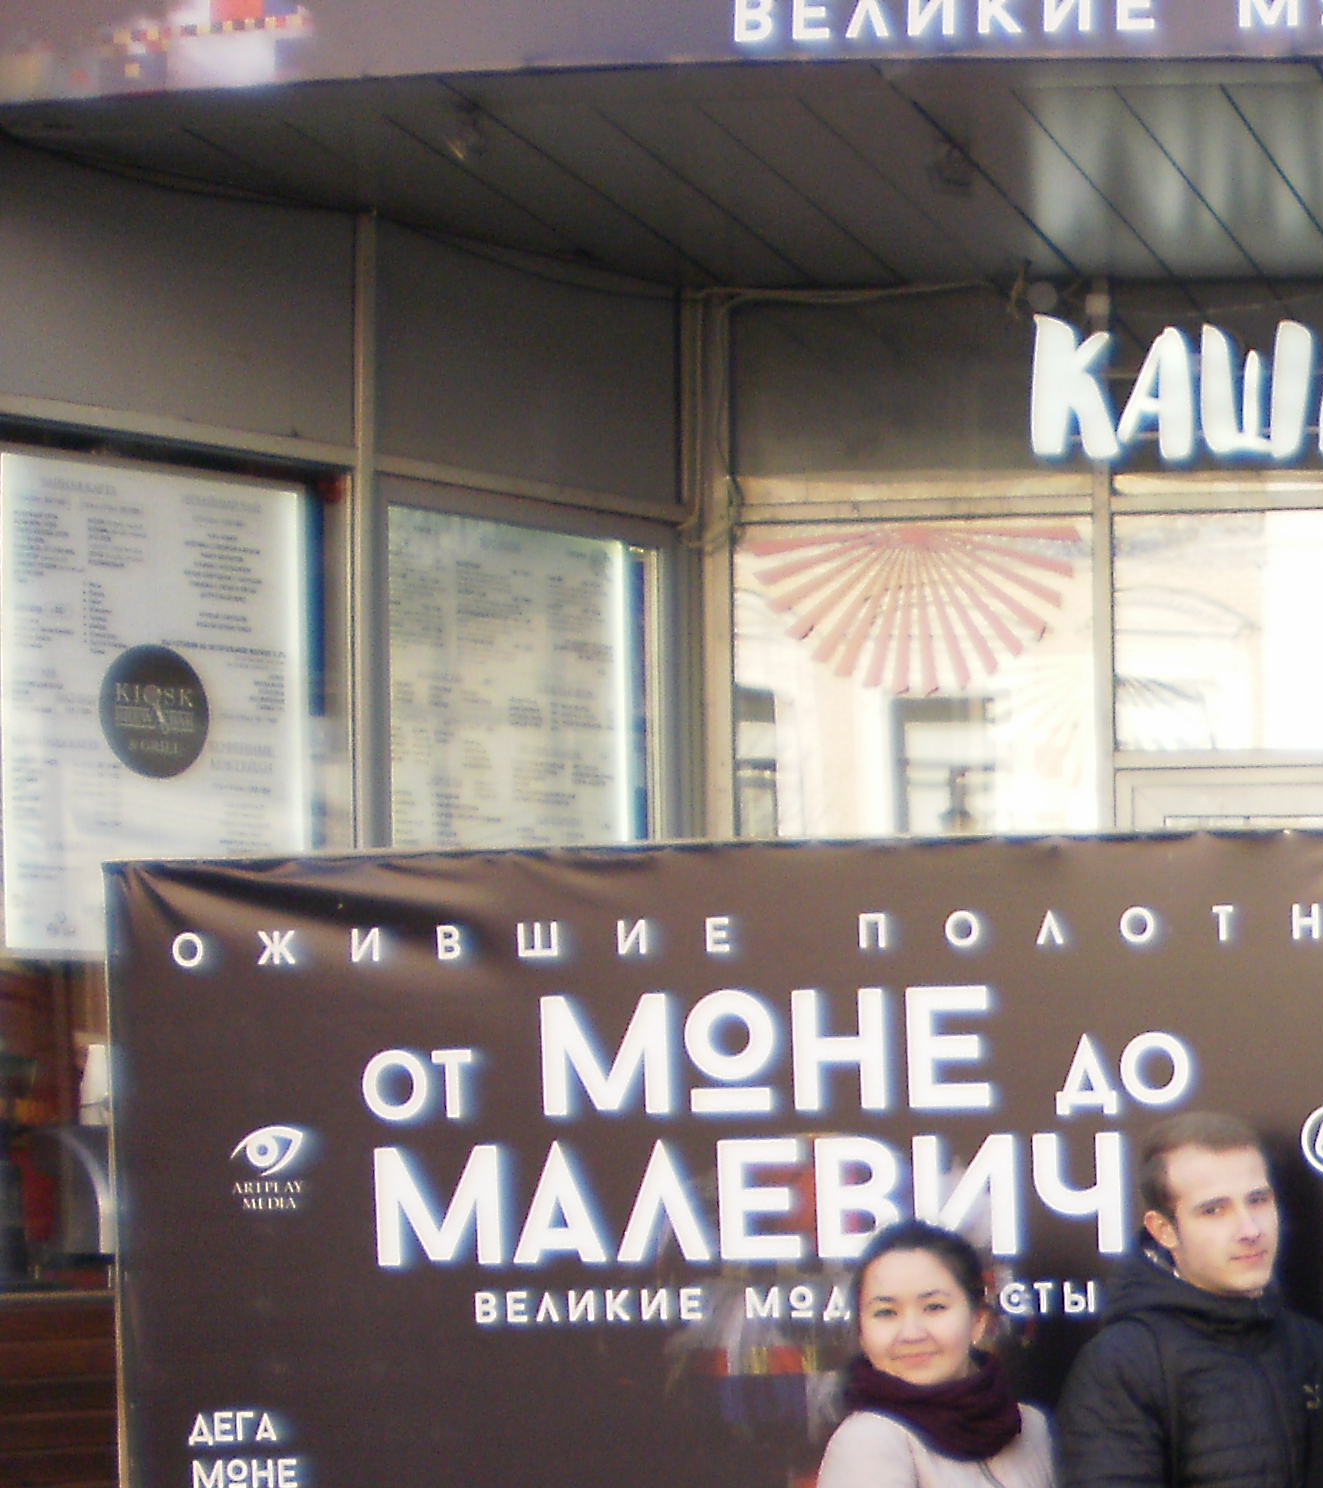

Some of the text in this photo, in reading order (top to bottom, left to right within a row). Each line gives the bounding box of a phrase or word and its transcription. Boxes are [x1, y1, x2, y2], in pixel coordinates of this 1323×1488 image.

[172, 916, 732, 968] ОЖИВШИЕ
[362, 985, 1190, 1119] ОТ МОНЕ ДО
[232, 1180, 303, 1195] ARTPLAY
[243, 1197, 297, 1210] MEDIA
[475, 1287, 703, 1323] ВЕЛИКИЕ
[189, 1411, 278, 1446] ДЕГА
